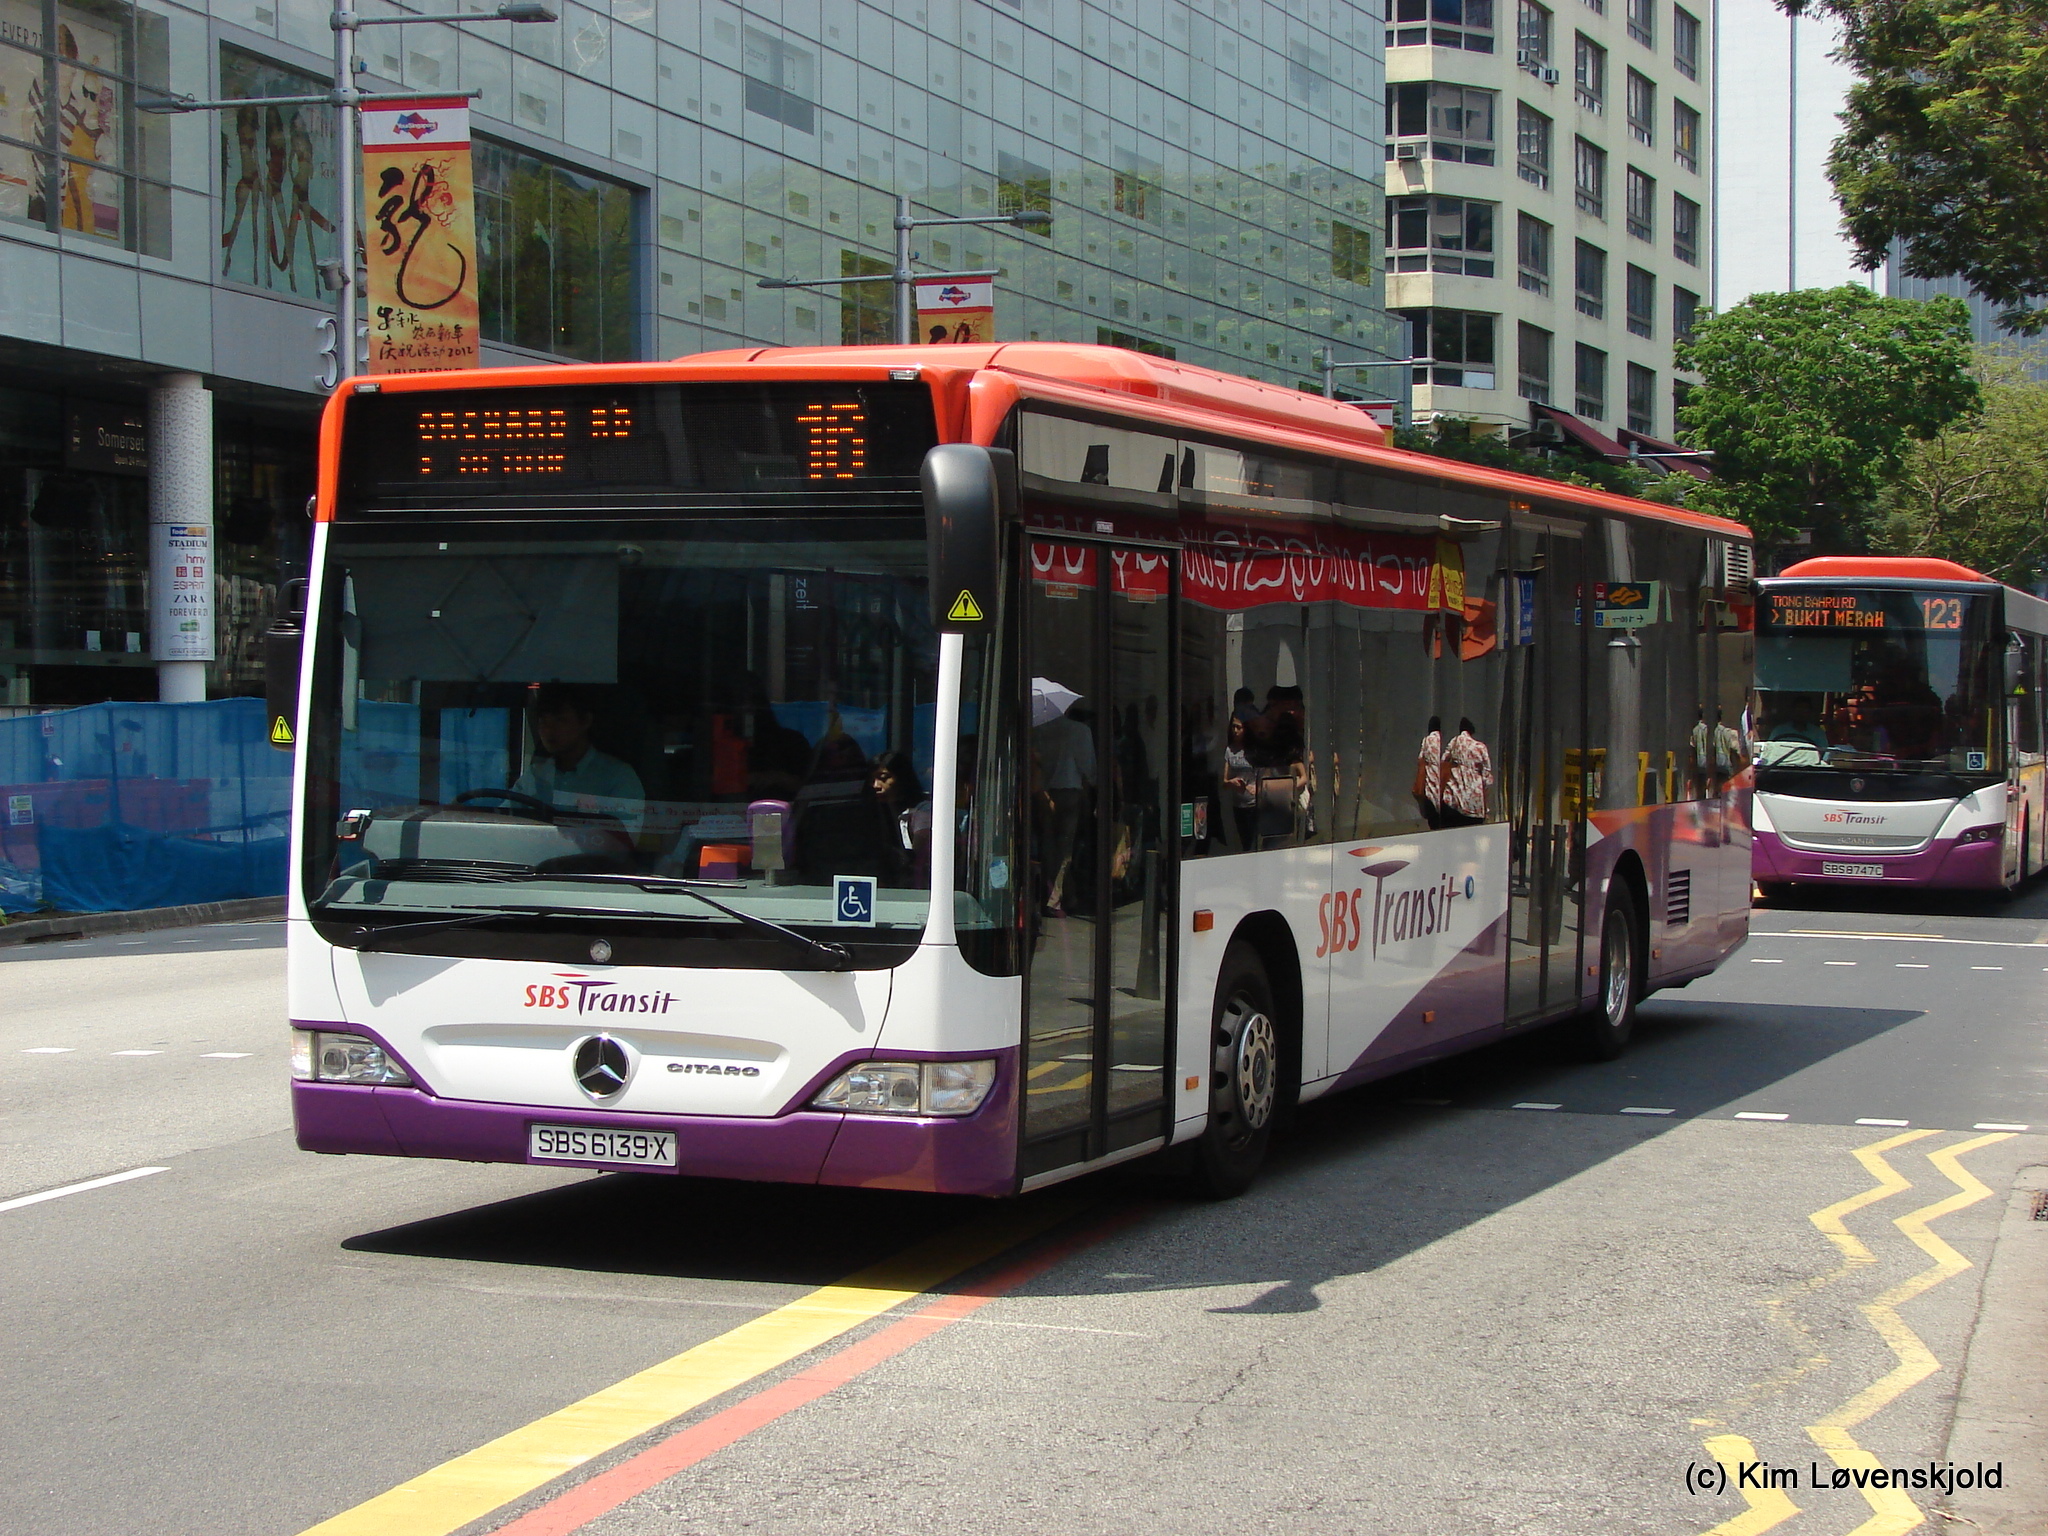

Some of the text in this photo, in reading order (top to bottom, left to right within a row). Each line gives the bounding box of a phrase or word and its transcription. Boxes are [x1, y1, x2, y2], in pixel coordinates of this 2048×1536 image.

[97, 426, 146, 452] Somerset
[168, 540, 208, 548] STADIUM
[185, 553, 206, 564] hmv
[173, 580, 206, 590] ESPRIT
[174, 594, 205, 603] ZARA
[1772, 595, 1802, 608] TIONG
[1804, 596, 1841, 609] BAHRU
[169, 607, 202, 617] FOREVER
[1785, 609, 1884, 627] BUKIT MERAH
[1921, 598, 1962, 629] 123
[1823, 811, 1888, 824] SBS Transit
[1824, 864, 1882, 876] SBS8747C
[1316, 860, 1462, 962] SBS Transit
[524, 981, 682, 1016] SBS Transit
[666, 1063, 761, 1077] CITARO
